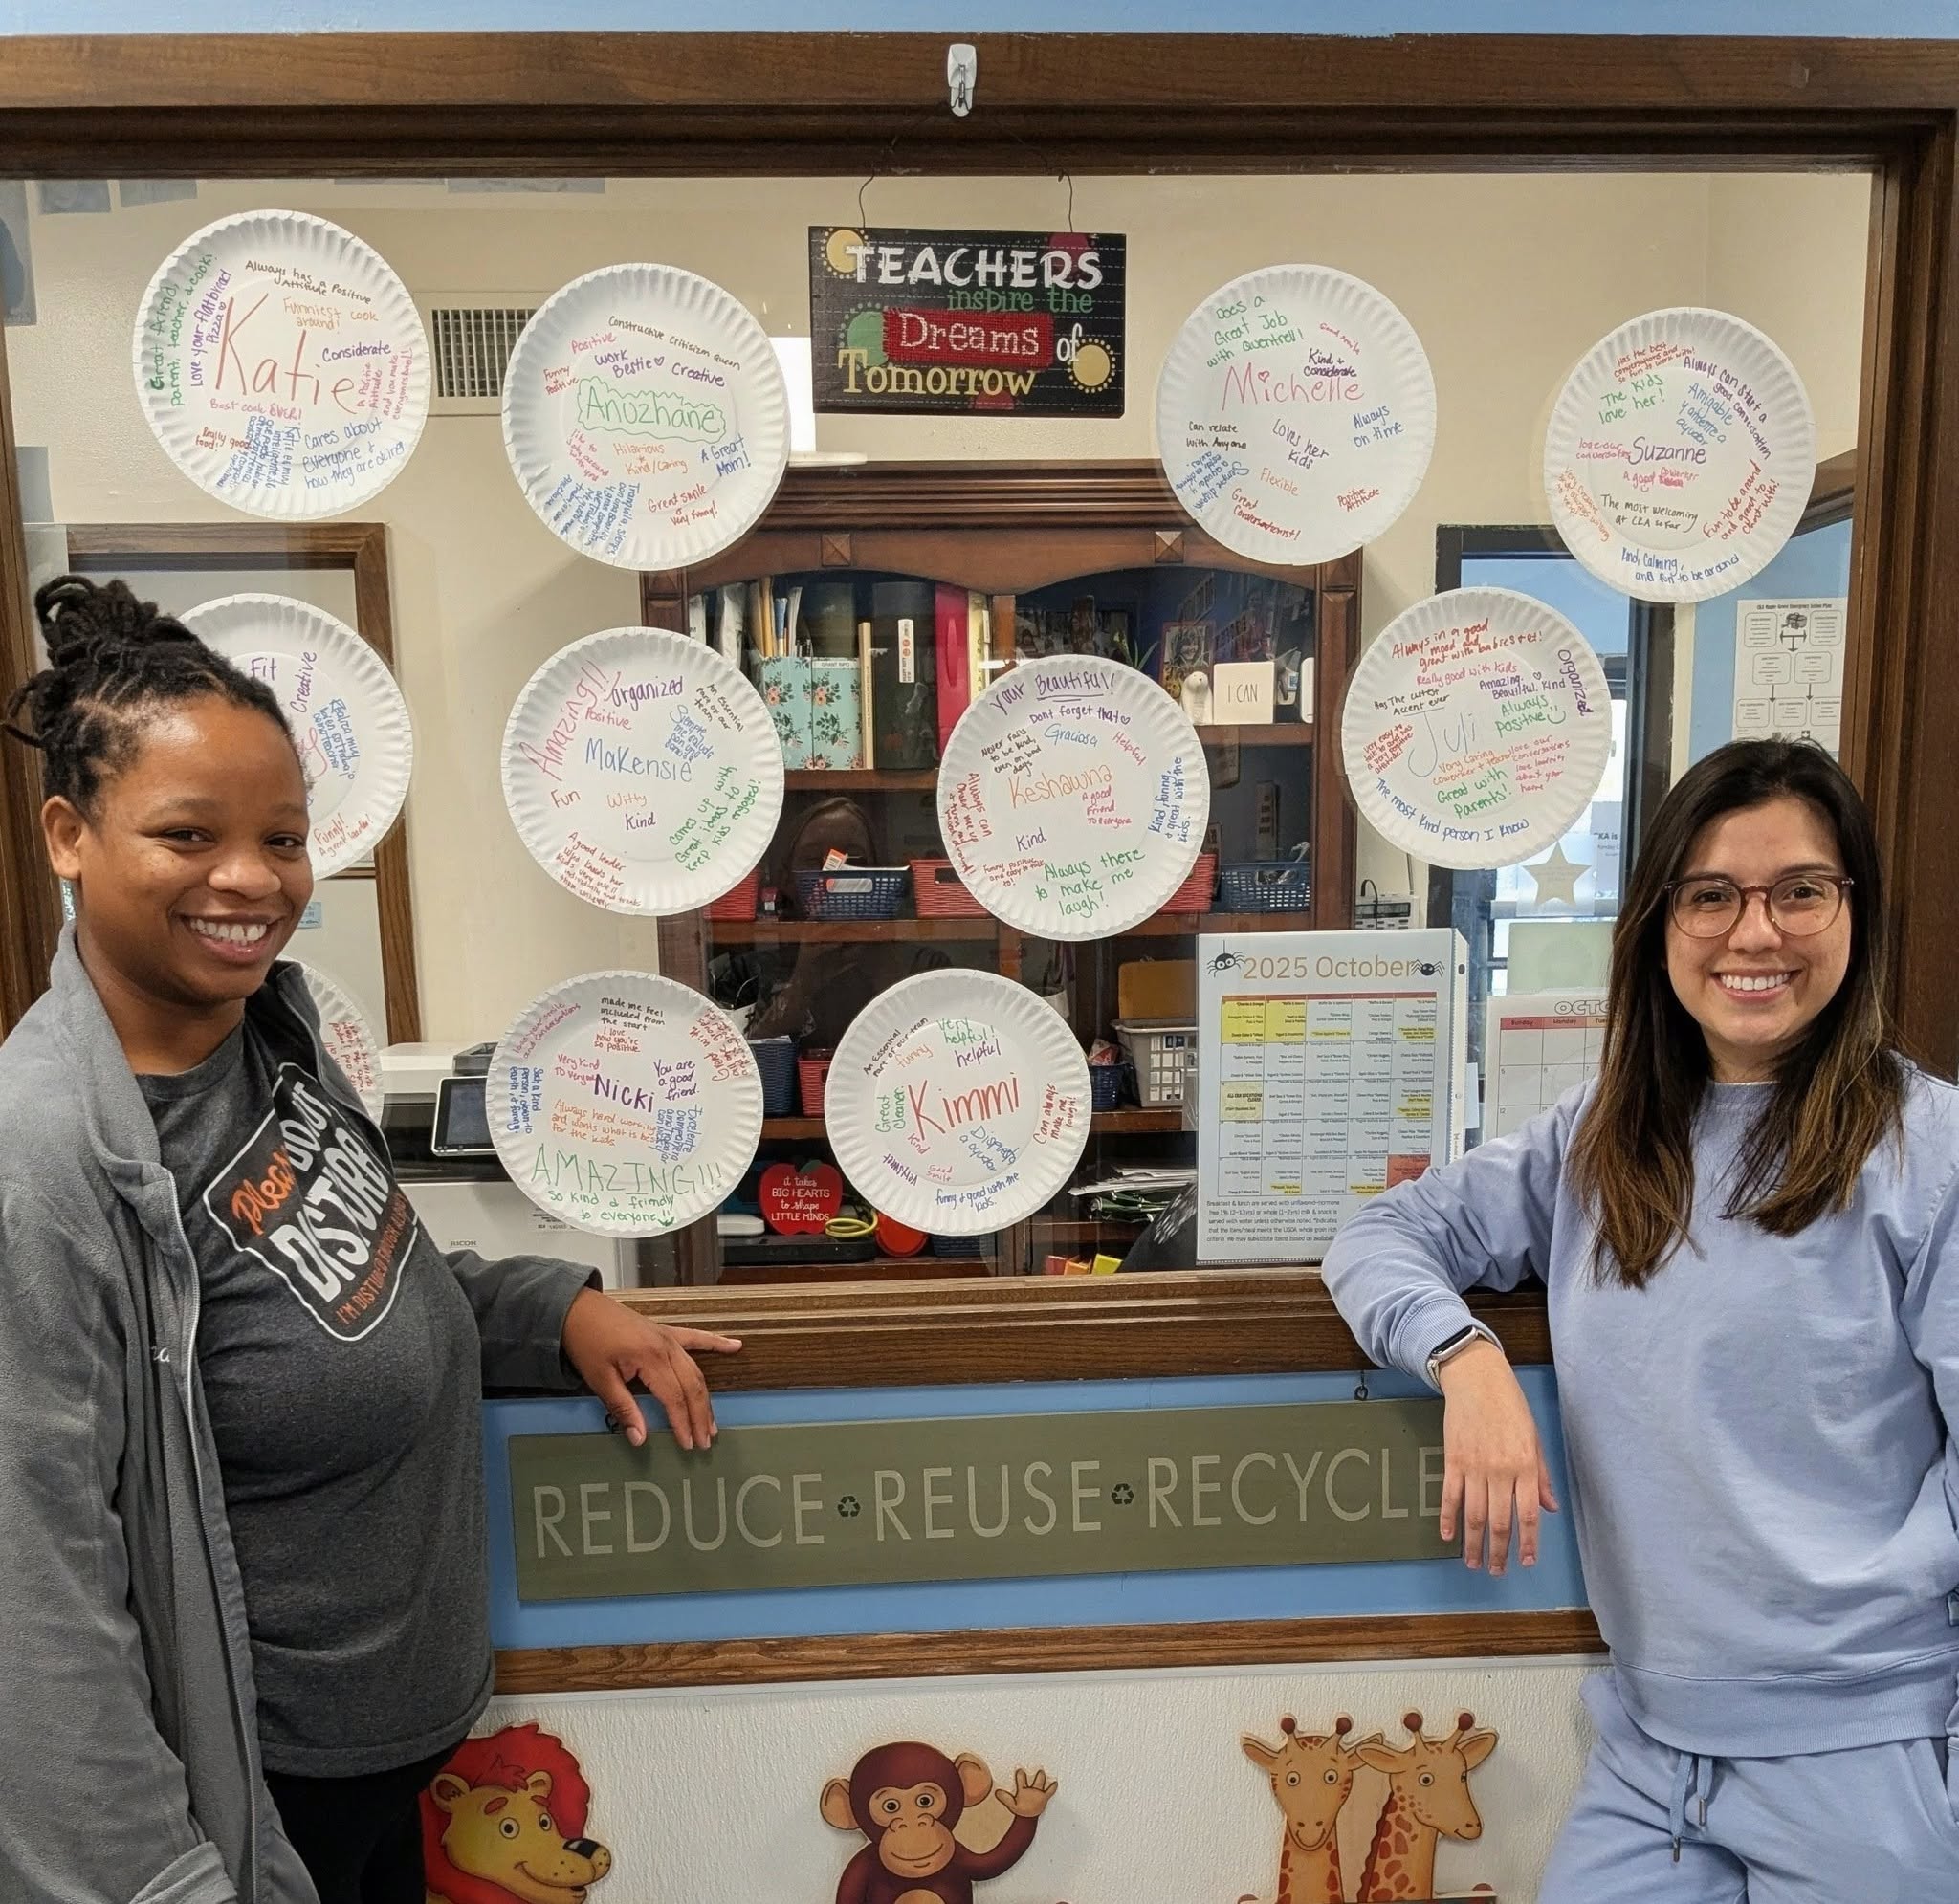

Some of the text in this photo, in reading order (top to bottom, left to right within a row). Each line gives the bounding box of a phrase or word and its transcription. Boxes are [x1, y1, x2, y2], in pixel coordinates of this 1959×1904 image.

[245, 260, 287, 284] Always
[293, 268, 313, 283] has
[846, 245, 1103, 290] TEACHERS
[947, 283, 1093, 313] inspire the
[571, 331, 616, 354] Positive
[900, 312, 1082, 362] Dreams of
[216, 293, 357, 414] Katie
[321, 342, 392, 361] Considerate
[1206, 348, 1235, 369] with
[1308, 347, 1334, 365] Kind
[671, 362, 726, 388] Creative
[838, 349, 1036, 396] Tomorrow
[1222, 362, 1364, 411] Michelle
[1601, 391, 1626, 407] The
[1684, 356, 1718, 379] Always
[1719, 369, 1739, 389] can
[1758, 413, 1768, 423] a
[1712, 383, 1733, 402] good
[1353, 405, 1390, 429] Always
[1598, 388, 1666, 425] love her!
[344, 417, 383, 437] about
[1272, 418, 1330, 459] Loves her
[1354, 422, 1404, 448] on time
[1629, 436, 1707, 466] Suzanne
[304, 474, 329, 490] how
[1260, 468, 1300, 496] Flexible
[1600, 493, 1620, 509] The
[1625, 500, 1650, 514] most
[1434, 631, 1447, 643] in
[250, 656, 277, 680] Fit
[290, 651, 318, 713] Creative
[1035, 671, 1117, 697] Beautiful!
[1236, 683, 1258, 703] CAN
[1500, 693, 1550, 718] Always
[518, 660, 610, 782] Amazing!!
[584, 707, 632, 731] Positive
[1402, 707, 1479, 778] Juli
[714, 764, 737, 792] with
[1007, 764, 1113, 810] Keshawna
[1473, 769, 1508, 790] with
[551, 788, 582, 809] Fun
[606, 792, 648, 809] Witty
[726, 786, 740, 801] to
[1015, 827, 1048, 852] Kind
[1044, 847, 1146, 883] Always there
[1112, 868, 1134, 886] me
[1059, 891, 1111, 918] laugh!
[1243, 955, 1417, 979] 2025 October
[894, 1043, 934, 1069] funny
[954, 1039, 1002, 1067] helpful
[653, 1059, 696, 1077] You are
[594, 1074, 656, 1113] Nicki
[658, 1072, 694, 1091] a good
[908, 1072, 1021, 1142] Kimmi
[531, 1143, 722, 1196] AMAZING!!!
[783, 1176, 817, 1186] it takes
[772, 1188, 830, 1197] BIG HEARTS
[781, 1199, 819, 1215] to shape
[803, 1213, 829, 1221] MINDS
[534, 1446, 1444, 1558] REDUCE REUSE RECYCLE
